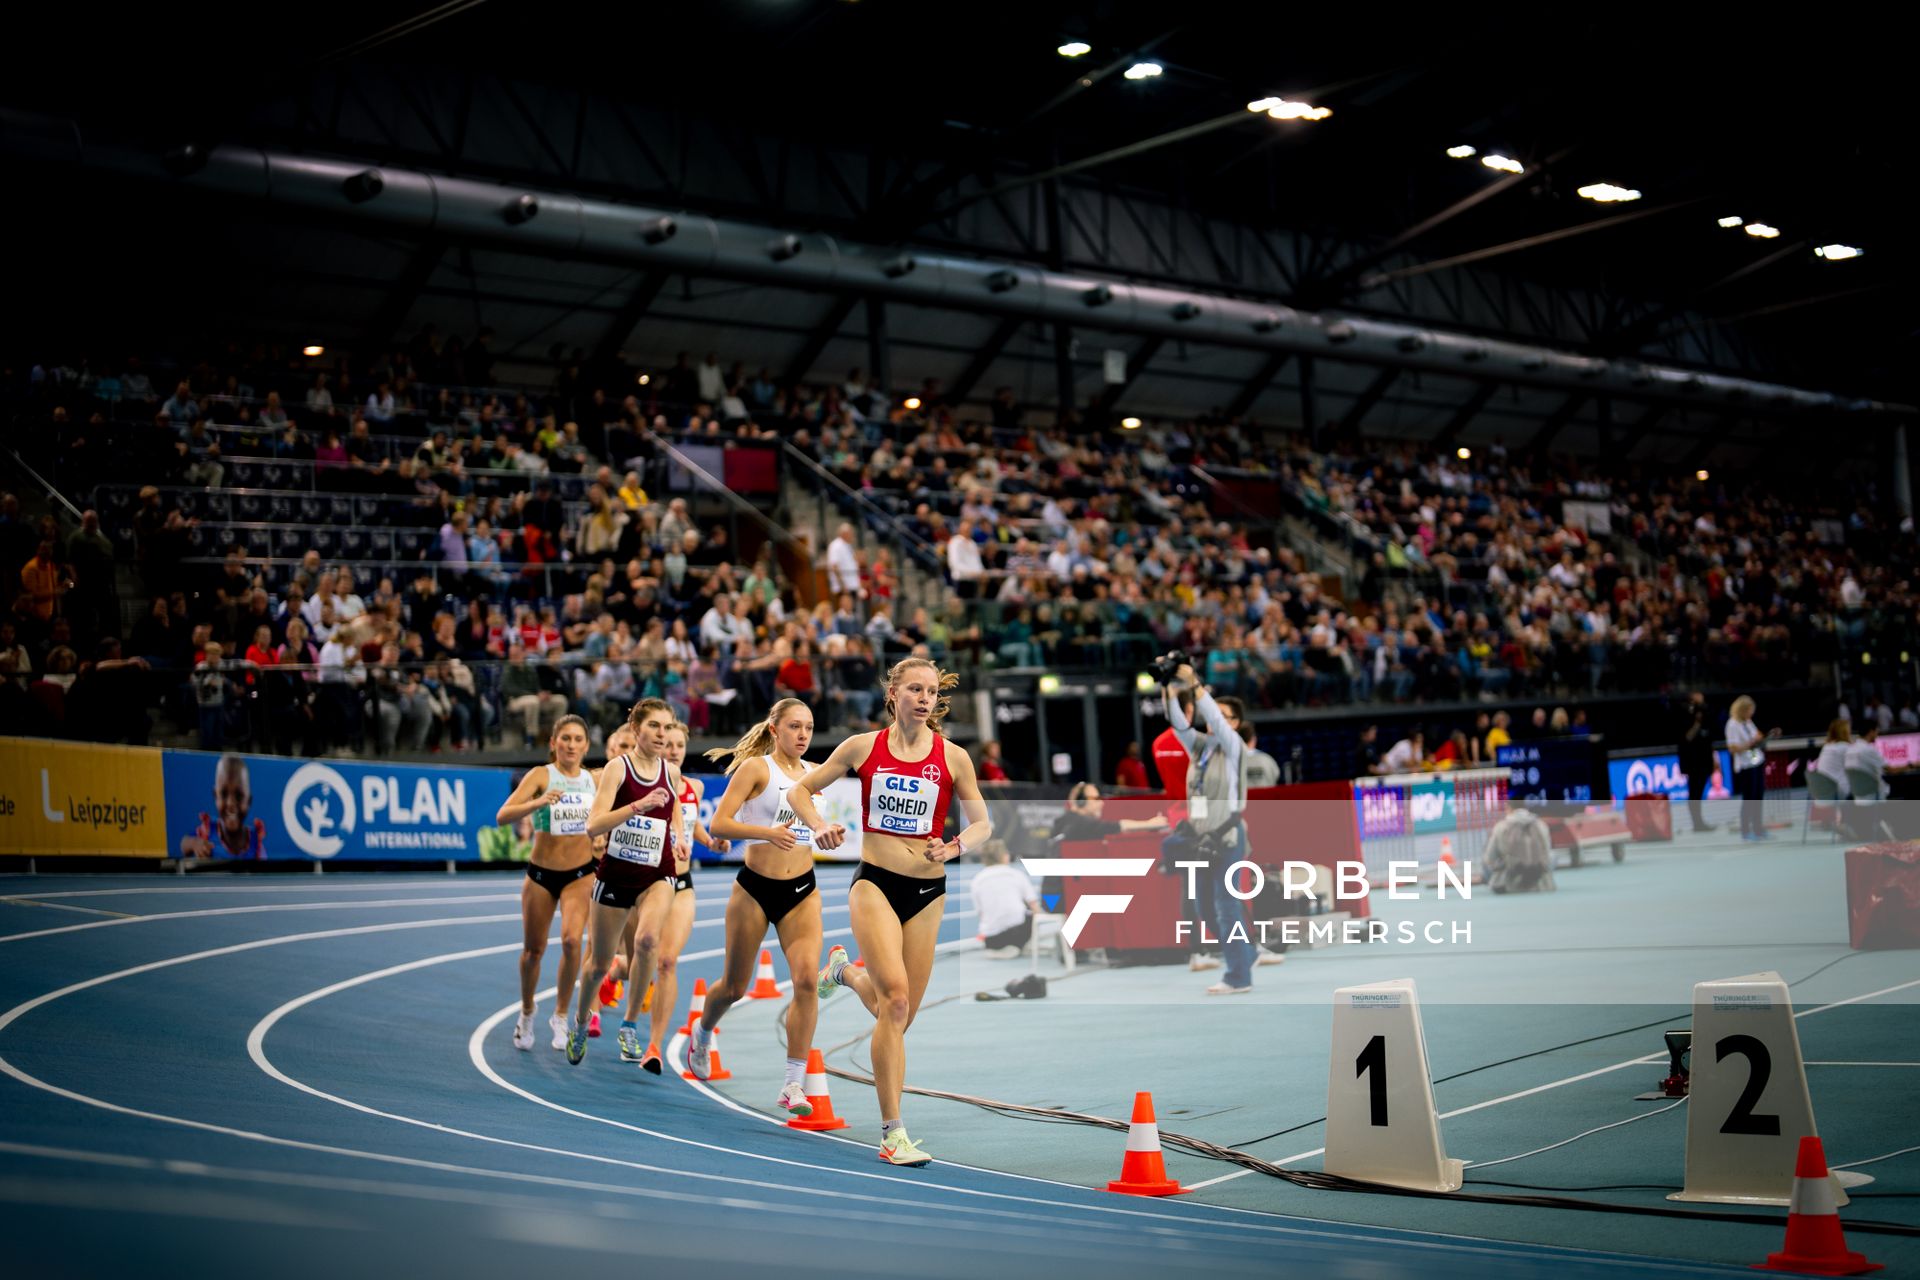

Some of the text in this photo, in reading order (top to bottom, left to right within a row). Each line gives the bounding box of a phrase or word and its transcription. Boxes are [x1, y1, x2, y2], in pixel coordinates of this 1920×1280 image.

[362, 775, 466, 826] PLAN
[878, 795, 928, 816] SCHEID
[68, 795, 146, 831] Leipziger
[554, 809, 591, 821] G.KRAUS
[896, 820, 916, 828] PLAN
[365, 831, 467, 849] INTERNATIONAL
[614, 829, 661, 850] COUTELLIER
[1356, 1035, 1388, 1127] 1
[1715, 1034, 1781, 1136] 2
